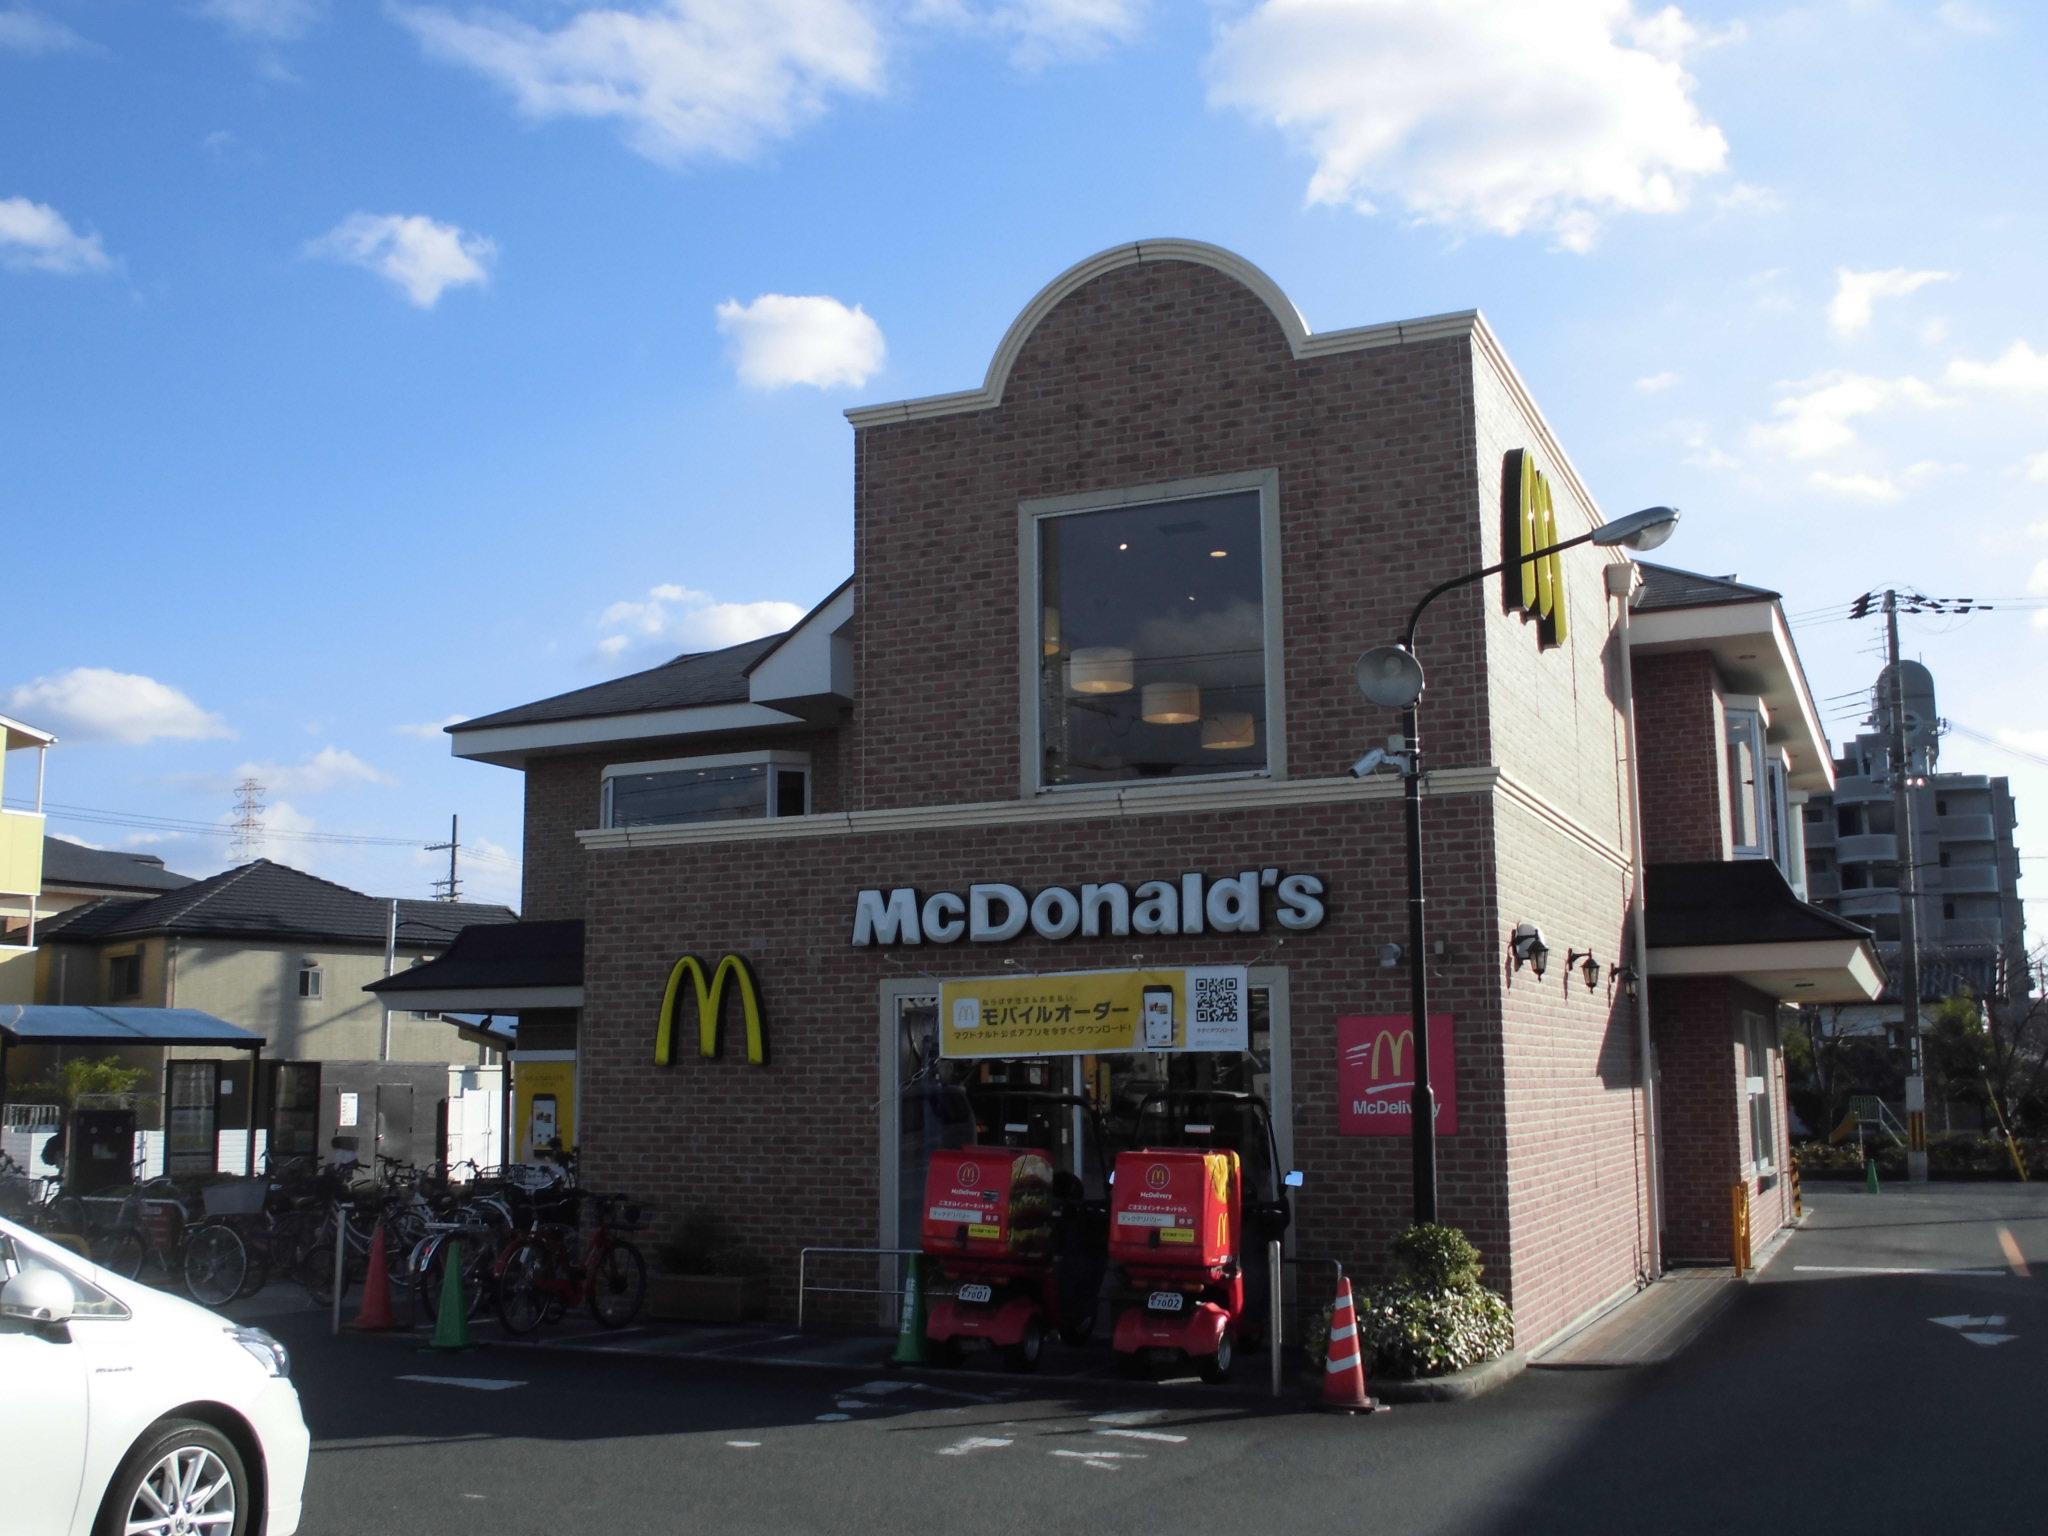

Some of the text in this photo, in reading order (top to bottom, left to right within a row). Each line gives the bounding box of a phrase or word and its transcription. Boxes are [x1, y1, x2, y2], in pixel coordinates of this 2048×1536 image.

[851, 868, 1325, 946] McDonald's
[982, 1001, 1129, 1026] モバイルオーダー
[1353, 1099, 1441, 1118] McDelivy
